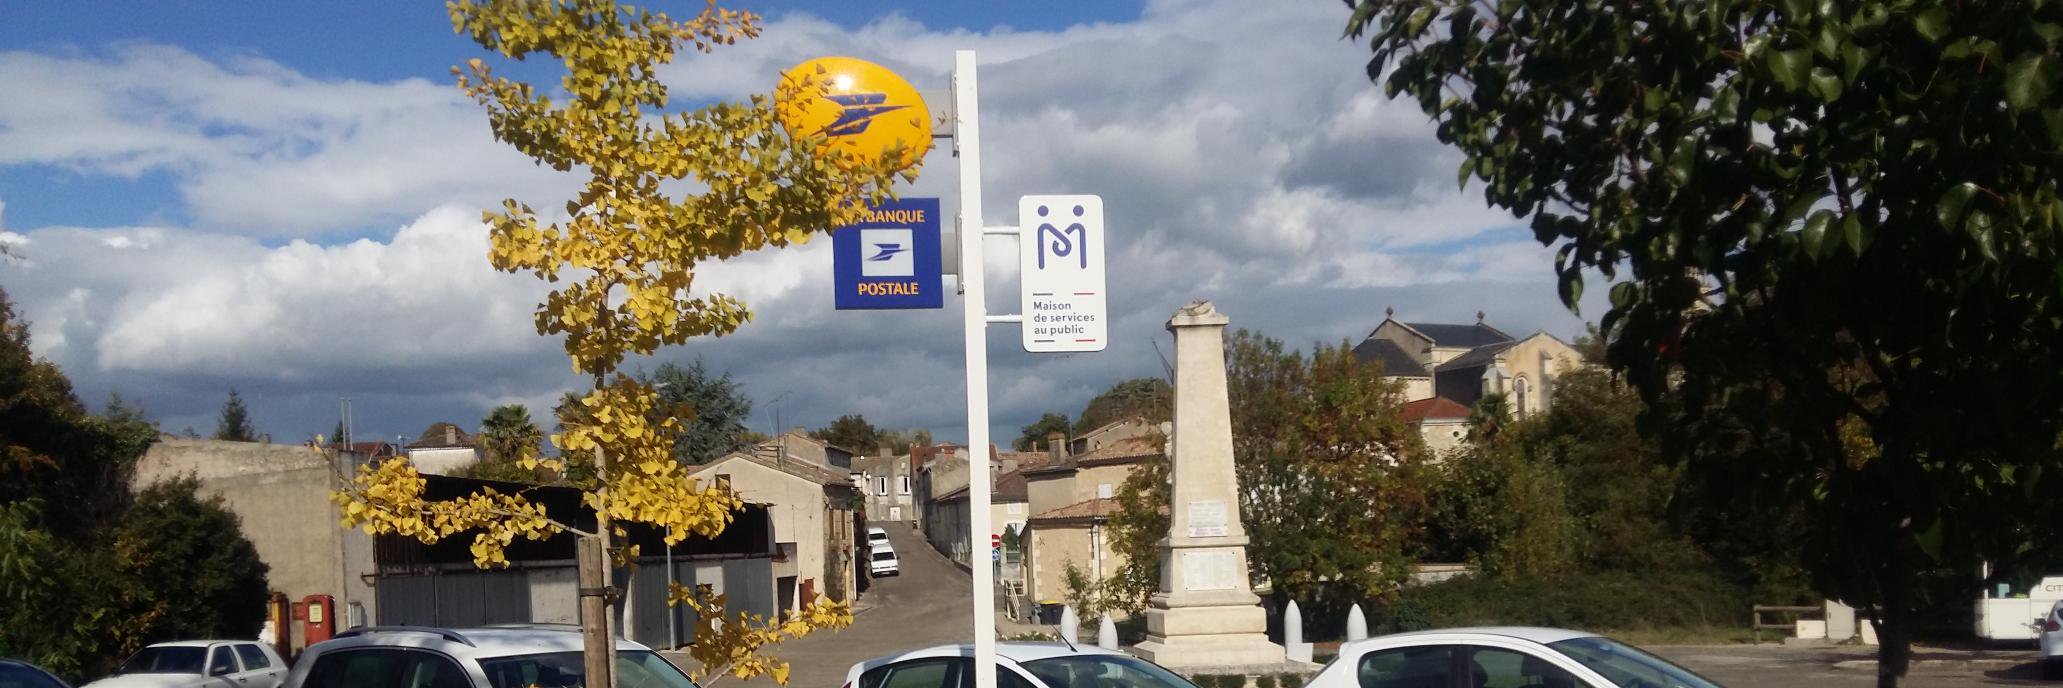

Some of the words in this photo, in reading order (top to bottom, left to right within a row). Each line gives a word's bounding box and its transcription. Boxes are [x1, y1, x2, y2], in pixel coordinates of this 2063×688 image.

[866, 209, 926, 224] BANQUE
[857, 282, 919, 296] POSTALE
[1033, 300, 1071, 310] Maison
[1033, 313, 1047, 322] de
[1050, 312, 1095, 322] services
[1050, 324, 1085, 336] public
